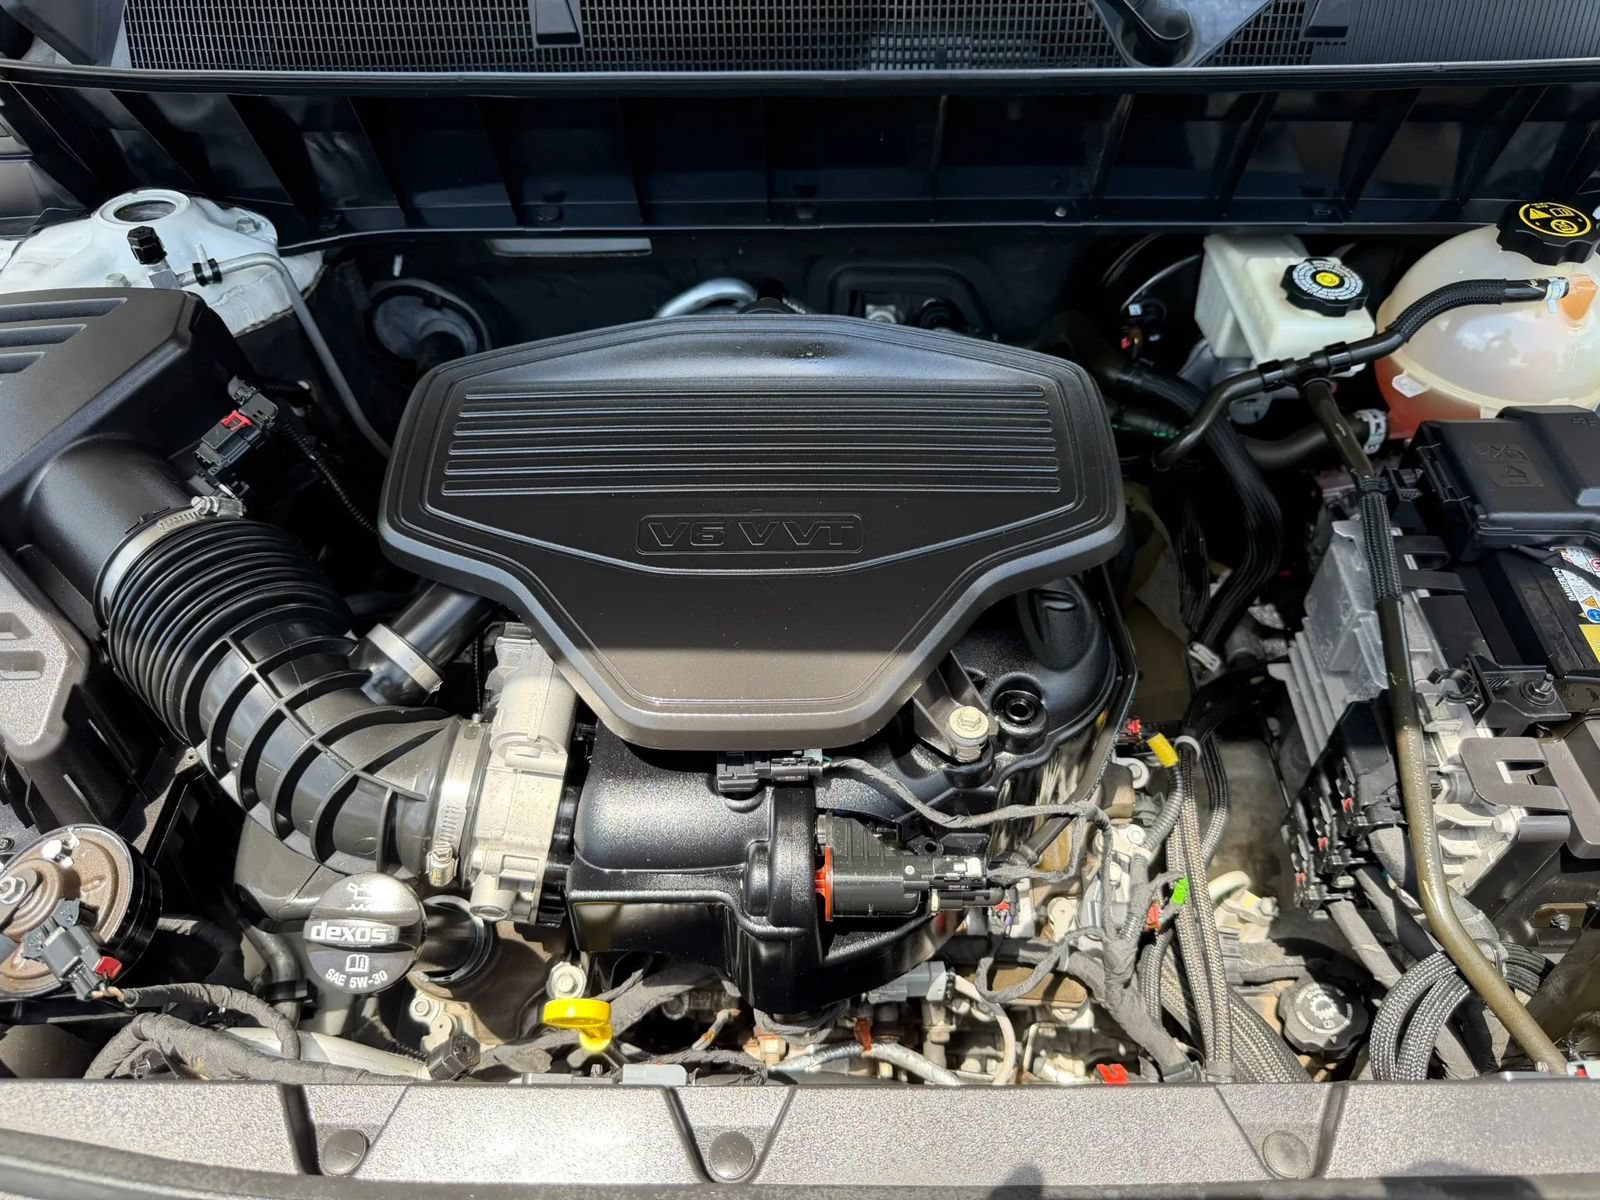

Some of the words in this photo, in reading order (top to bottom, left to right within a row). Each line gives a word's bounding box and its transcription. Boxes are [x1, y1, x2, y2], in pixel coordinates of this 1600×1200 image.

[648, 521, 726, 547] V6
[738, 521, 854, 546] VVT
[310, 920, 390, 943] dexos
[324, 968, 347, 986] SAE
[349, 970, 388, 989] 5W-30
